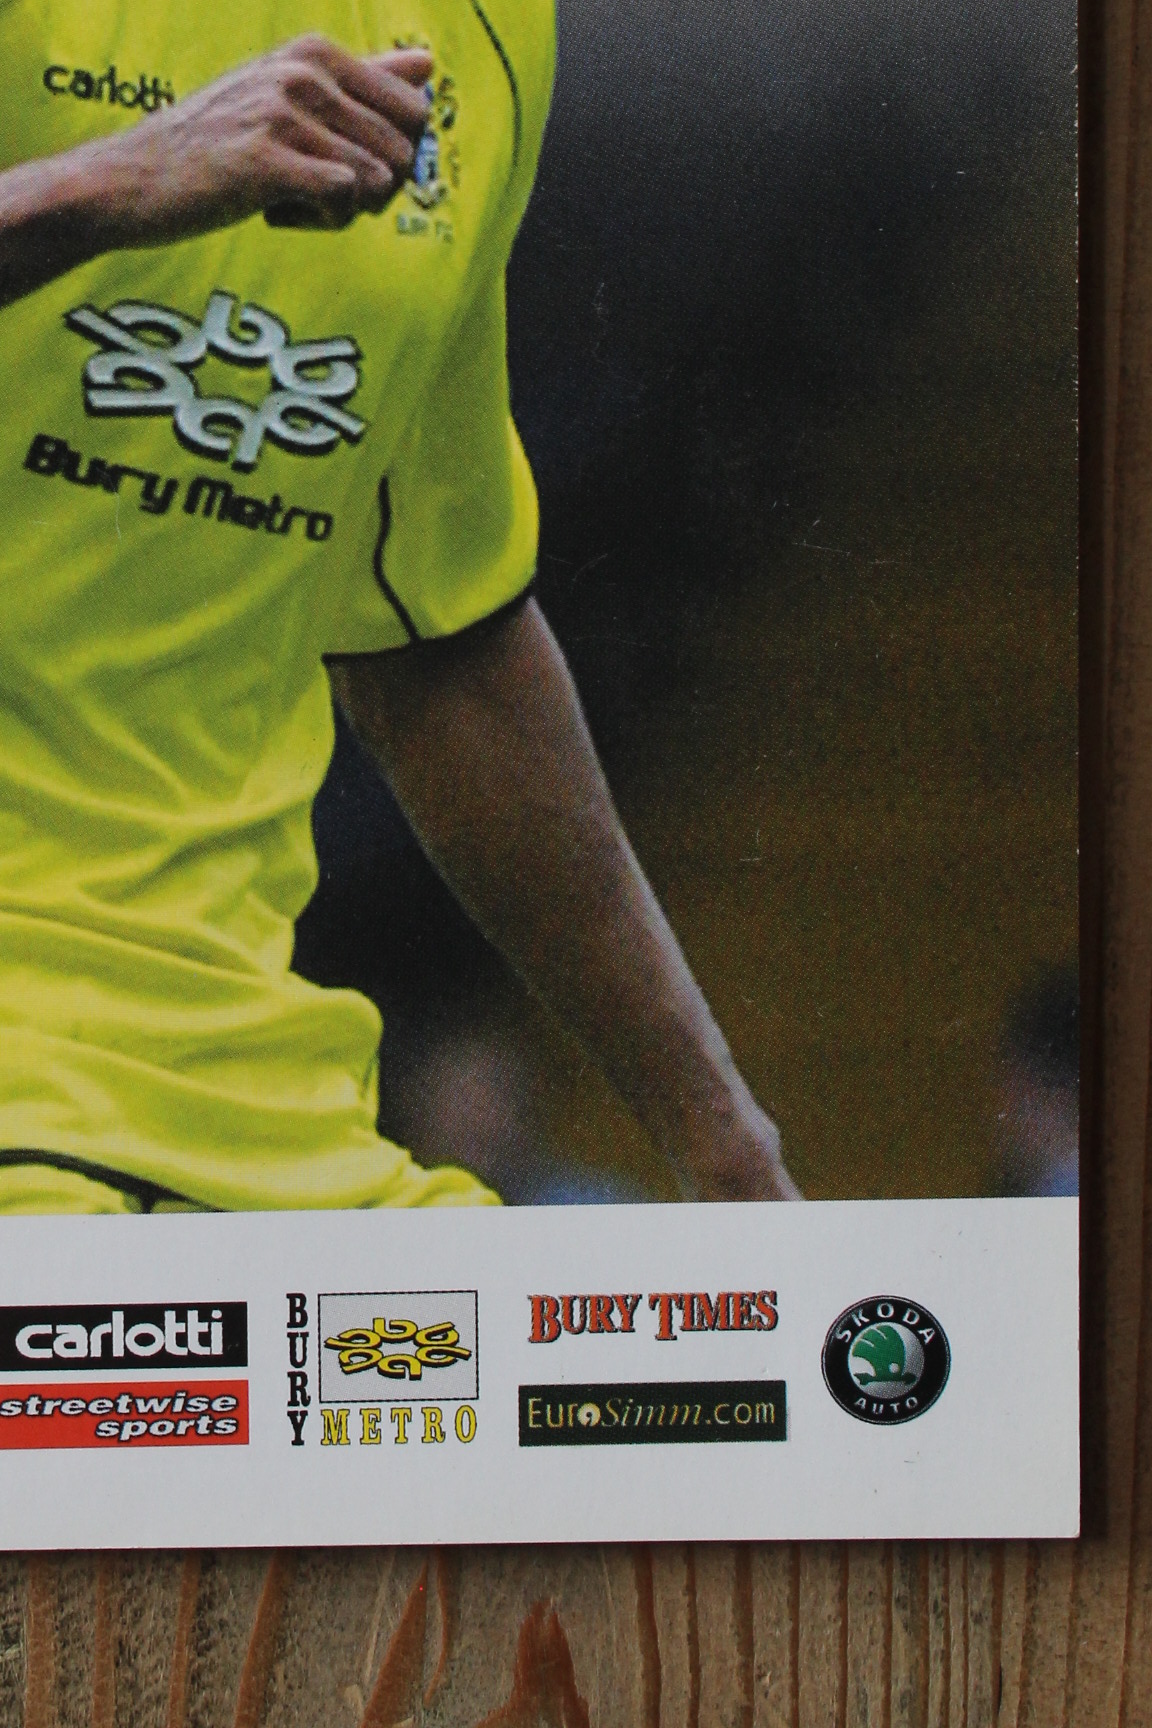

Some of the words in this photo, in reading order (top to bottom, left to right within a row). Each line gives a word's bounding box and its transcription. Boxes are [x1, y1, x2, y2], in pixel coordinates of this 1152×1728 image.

[23, 432, 179, 515] Bury
[183, 476, 335, 541] Metro
[14, 1309, 224, 1358] carlotti
[527, 1293, 641, 1344] BURY
[649, 1290, 778, 1341] TIMES
[835, 1303, 934, 1344] SKODA
[286, 1292, 311, 1446] BURY
[0, 1391, 237, 1417] streetwise
[854, 1396, 919, 1414] AUTO
[96, 1416, 237, 1442] sports
[321, 1405, 478, 1446] METRO
